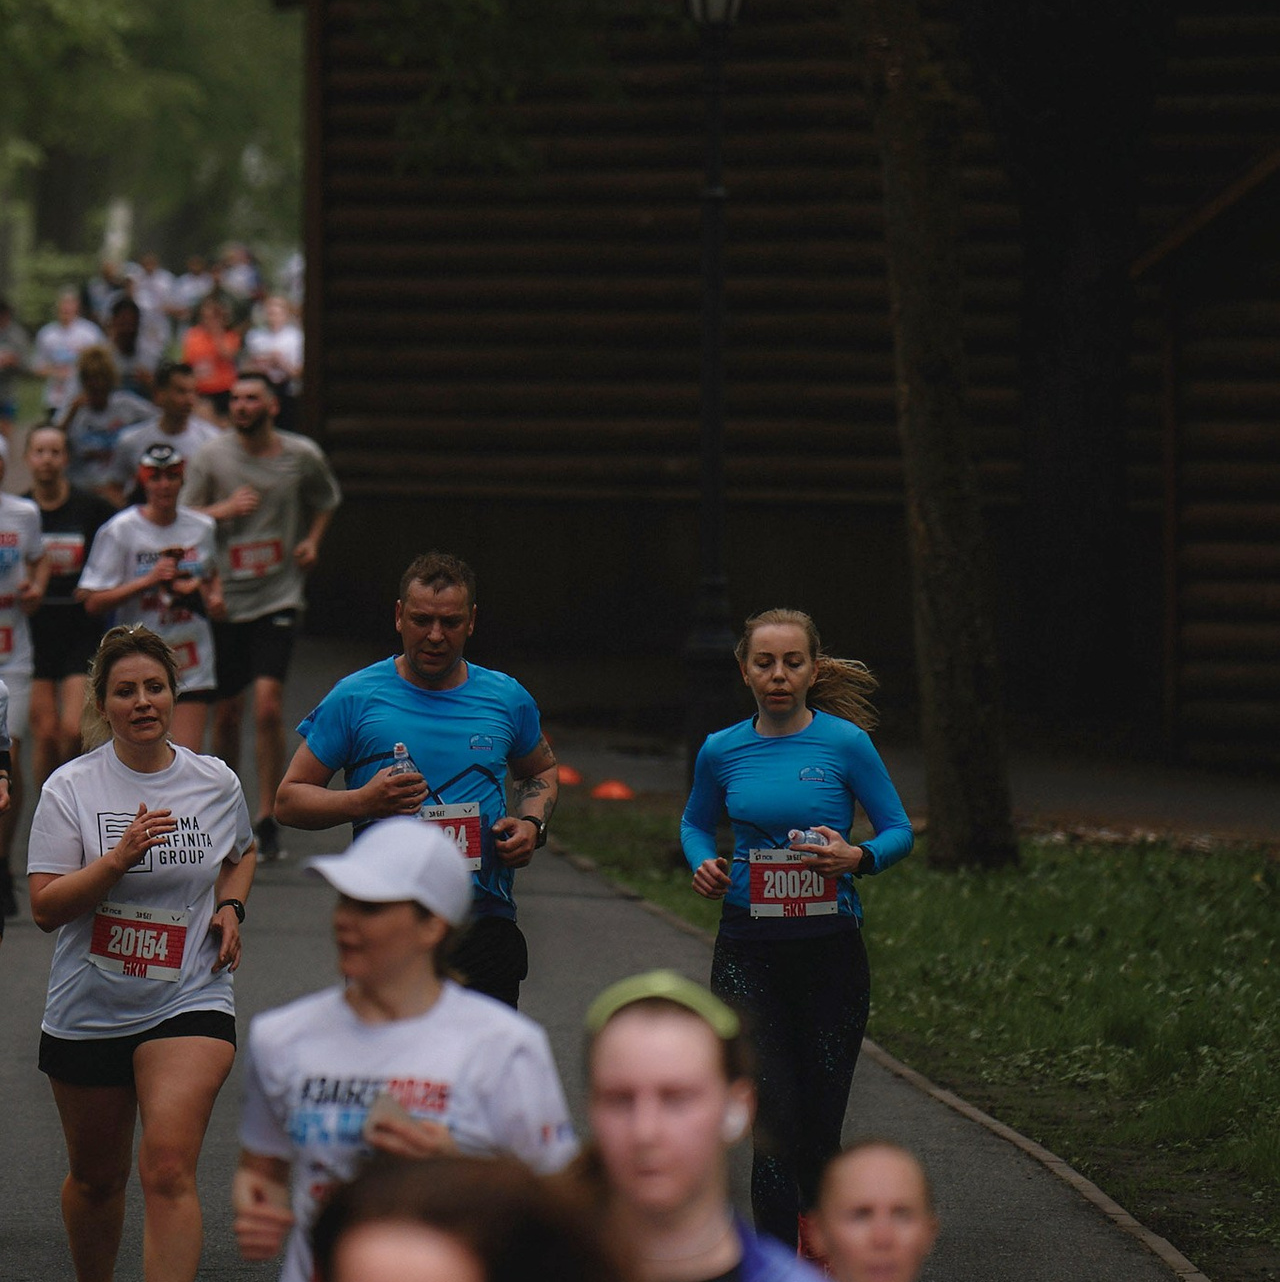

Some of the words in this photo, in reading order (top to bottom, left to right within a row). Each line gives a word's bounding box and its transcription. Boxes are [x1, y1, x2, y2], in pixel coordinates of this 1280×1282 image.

[159, 849, 205, 865] GROUP
[763, 869, 825, 900] 20020
[107, 925, 169, 962] 20154
